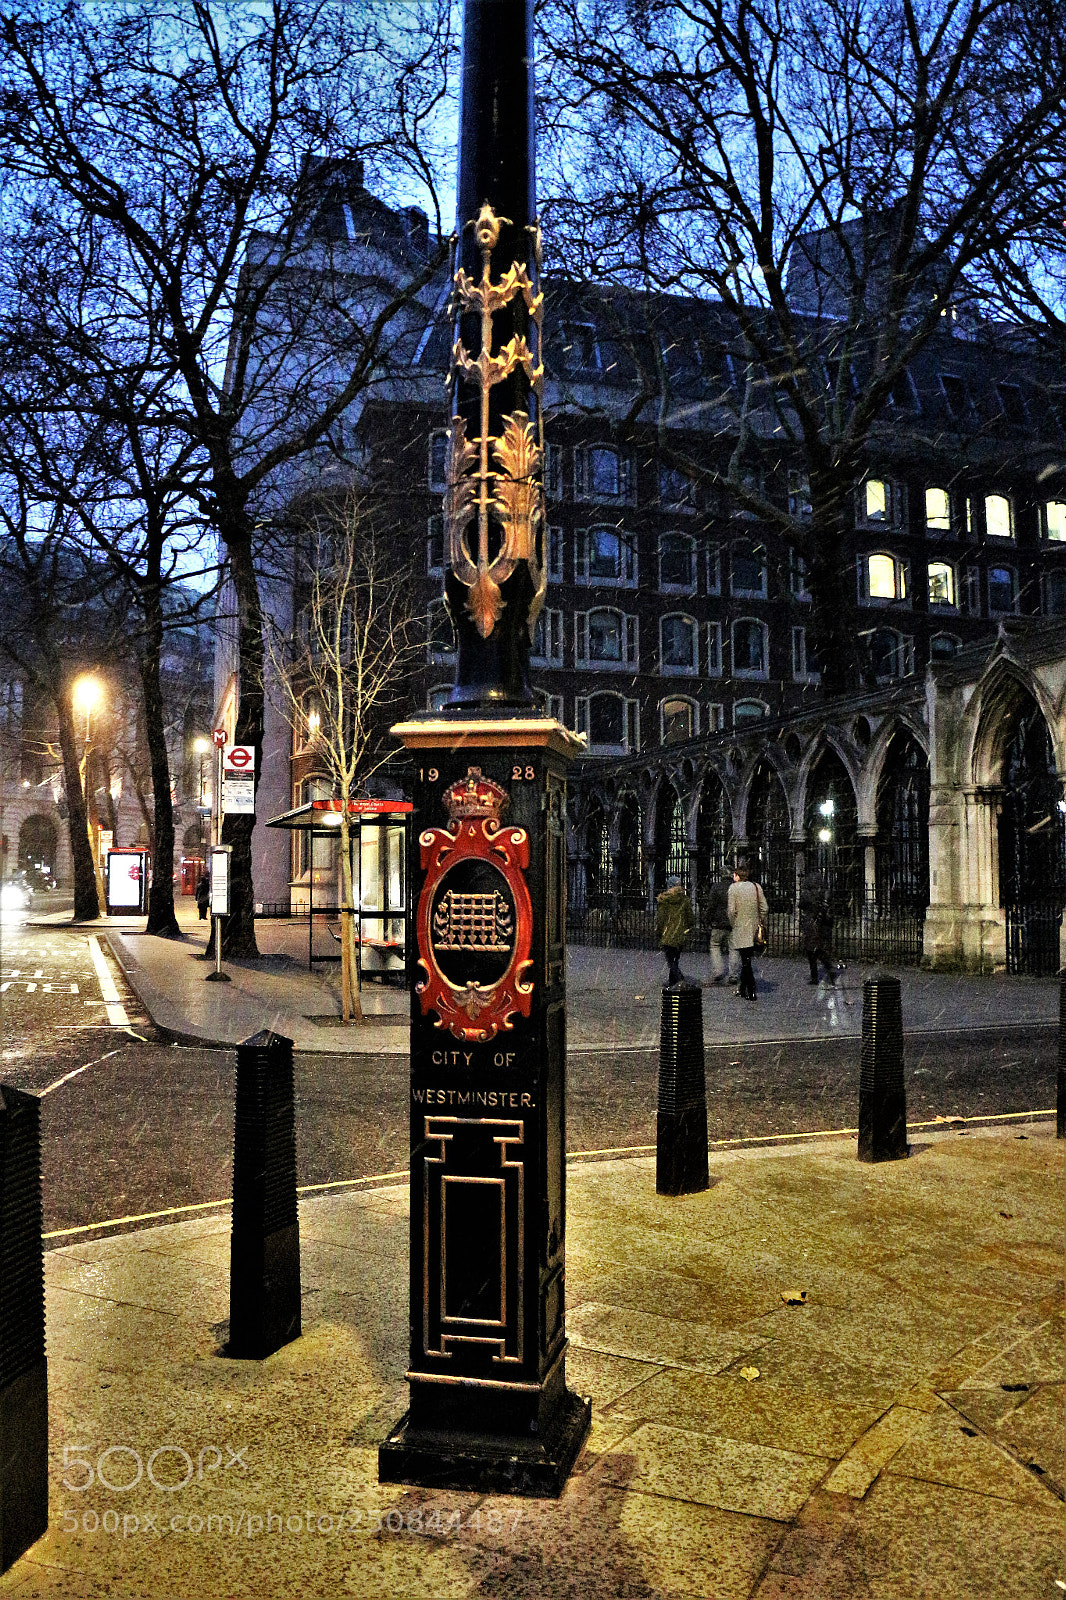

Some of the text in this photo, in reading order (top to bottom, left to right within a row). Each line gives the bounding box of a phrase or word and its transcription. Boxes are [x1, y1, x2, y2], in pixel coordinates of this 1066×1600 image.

[214, 731, 226, 743] M
[419, 765, 535, 783] 19 28
[432, 1050, 516, 1067] CITY OF
[412, 1088, 536, 1108] WESTMINSTER.
